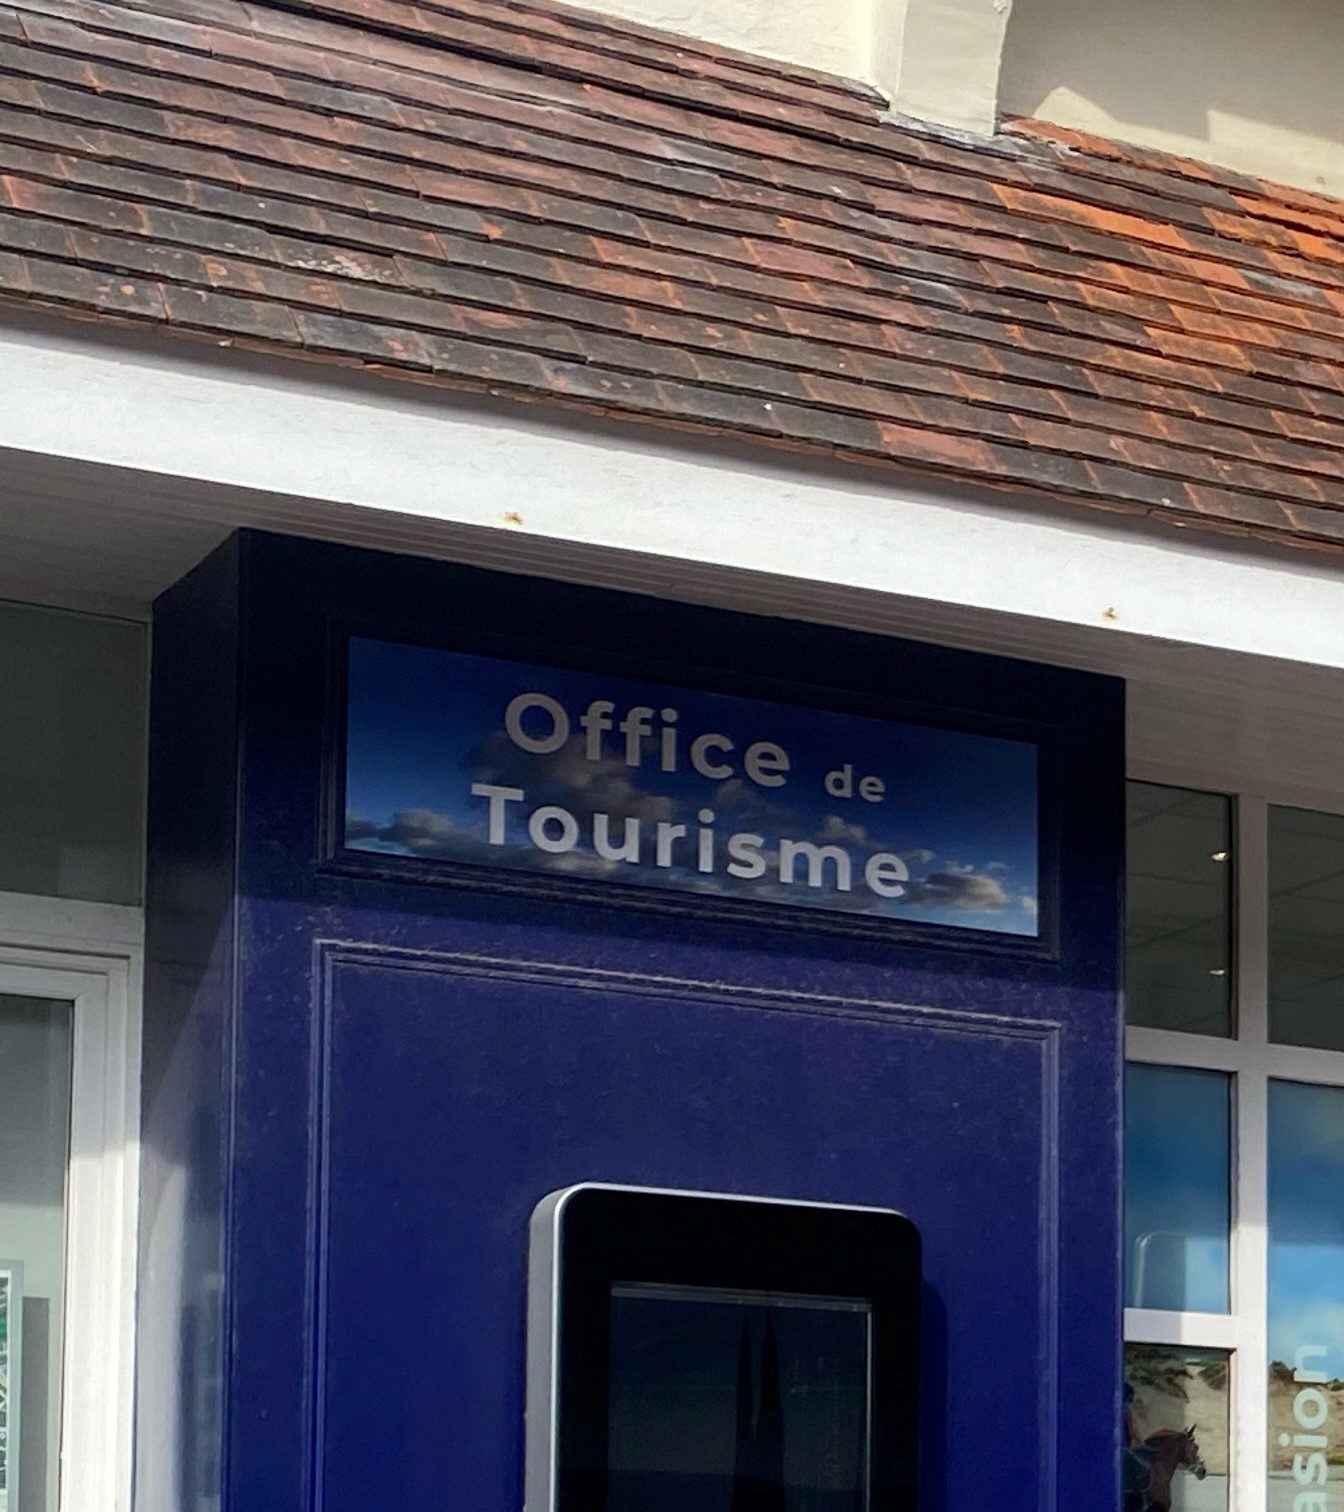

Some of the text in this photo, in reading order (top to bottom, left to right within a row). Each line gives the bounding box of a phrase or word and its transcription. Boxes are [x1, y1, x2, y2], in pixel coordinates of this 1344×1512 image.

[504, 691, 886, 803] Office de
[471, 783, 911, 899] Tourisme
